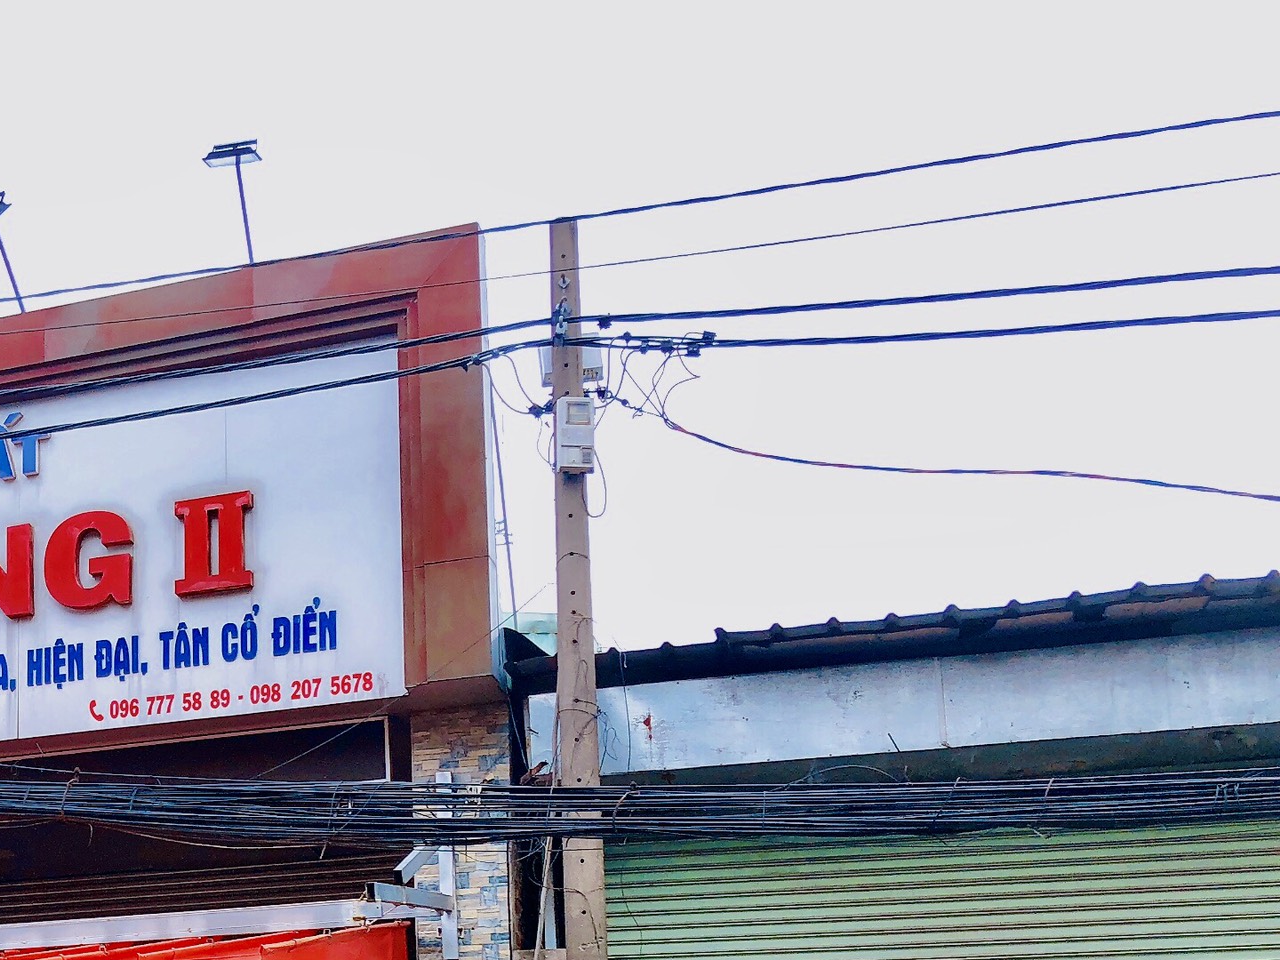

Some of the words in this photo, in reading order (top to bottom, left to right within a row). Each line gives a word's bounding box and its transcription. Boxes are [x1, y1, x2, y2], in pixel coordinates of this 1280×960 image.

[174, 489, 254, 598] II
[27, 637, 84, 690] HIỆN
[94, 635, 148, 682] ĐẠI,
[159, 621, 210, 671] TÂN
[221, 603, 260, 663] CỔ
[271, 596, 338, 657] ĐIỂN
[109, 697, 140, 719] 096
[146, 694, 175, 716] 777
[182, 691, 203, 712] 58
[210, 688, 231, 710] 89
[249, 682, 281, 705] 098
[290, 678, 321, 700] 207
[330, 672, 373, 696] 5678
